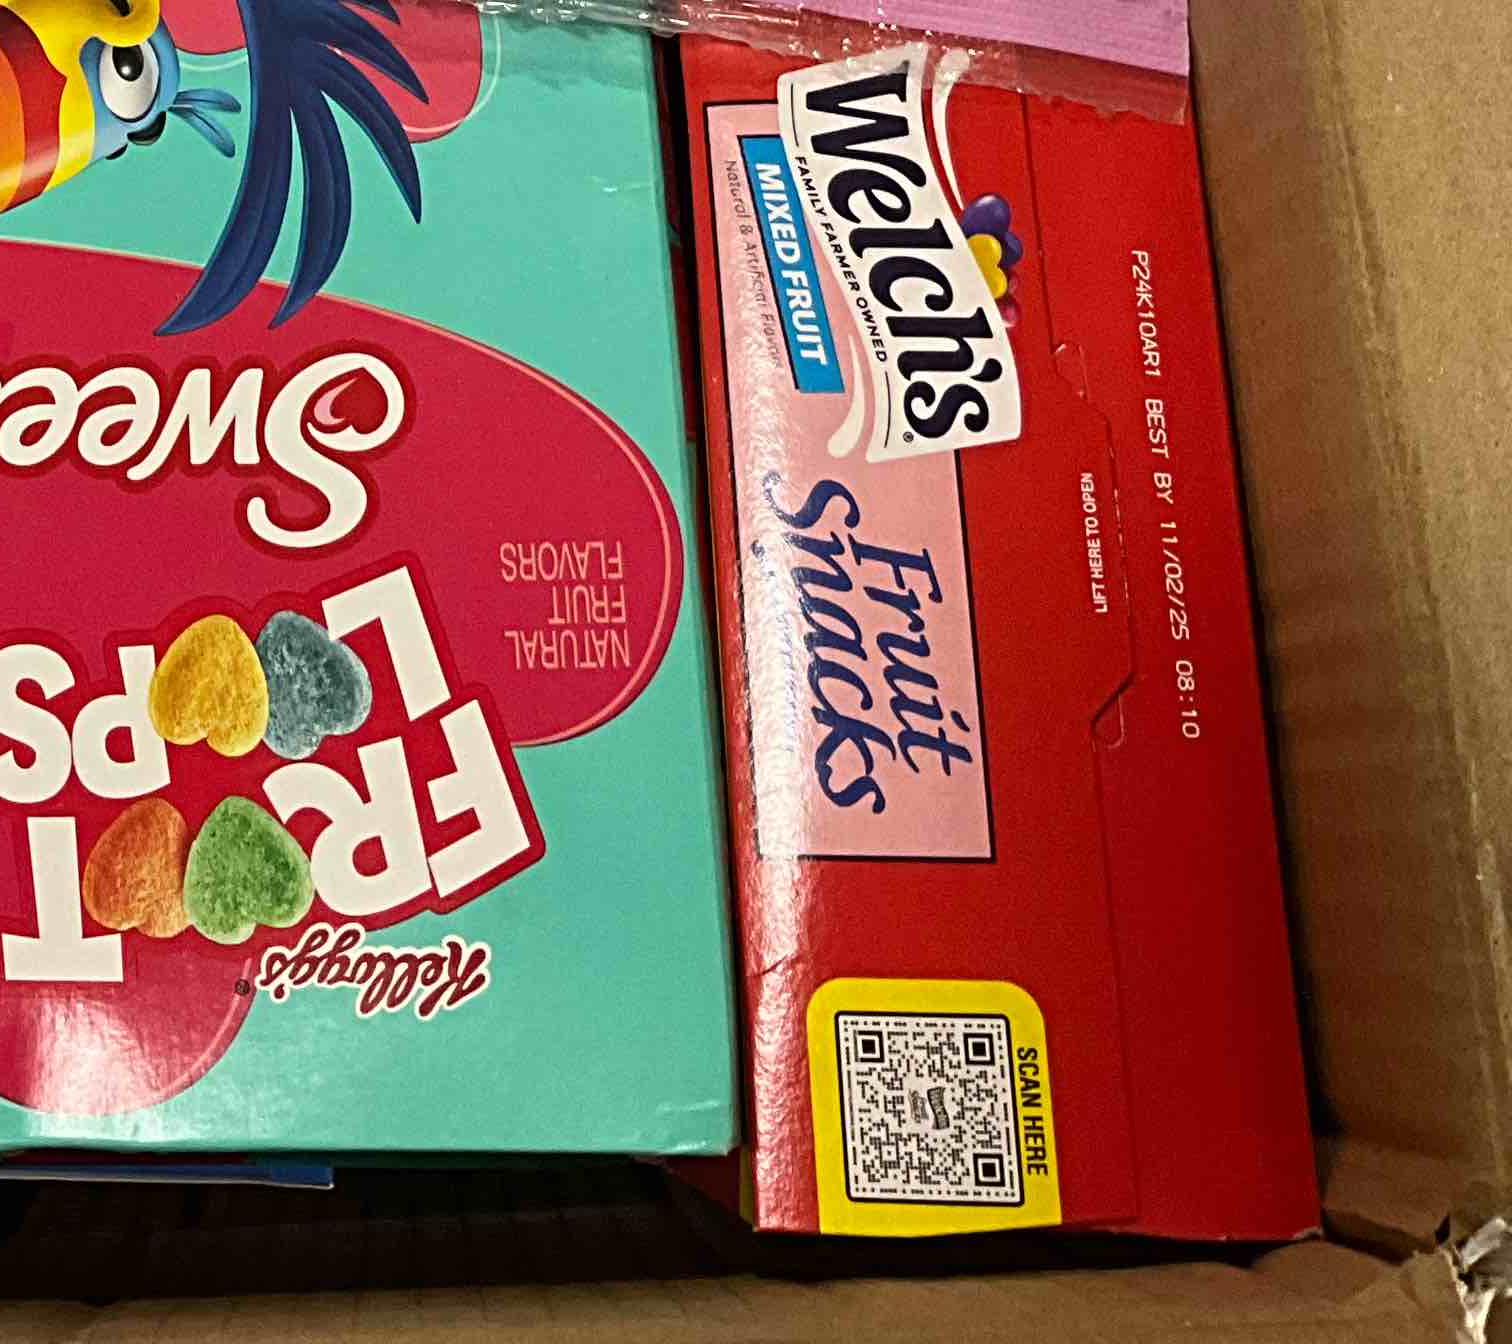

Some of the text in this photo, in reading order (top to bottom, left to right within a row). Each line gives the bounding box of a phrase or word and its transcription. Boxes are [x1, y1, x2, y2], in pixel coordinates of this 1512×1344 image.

[754, 162, 829, 367] MIXED FRUIT
[794, 155, 889, 363] FAMILY FARMER OWNED
[804, 59, 1002, 443] Welch's
[498, 539, 625, 583] FLAVORS
[1079, 471, 1109, 615] LIFT HERE TO OPEN
[1129, 248, 1201, 740] P24K10AR1 BEST BY 11/02/25 08:10
[503, 628, 631, 670] NATURAL
[547, 584, 628, 625] FRUIT
[765, 475, 888, 818] Snacks
[848, 535, 978, 778] Fruit
[1016, 1046, 1050, 1177] SCAN HERE
